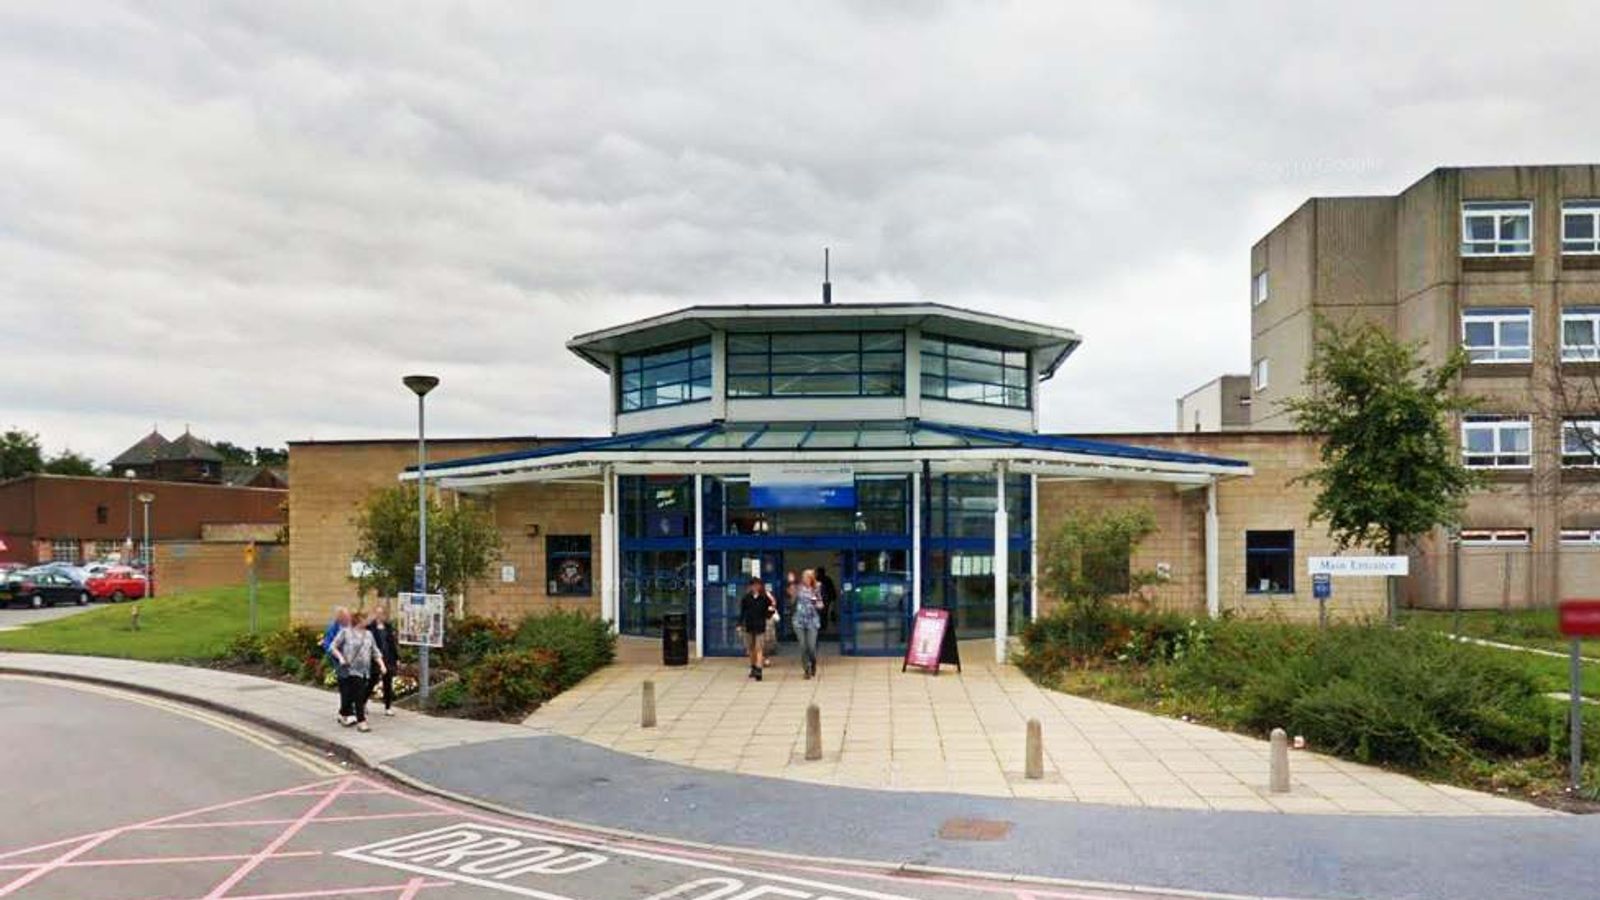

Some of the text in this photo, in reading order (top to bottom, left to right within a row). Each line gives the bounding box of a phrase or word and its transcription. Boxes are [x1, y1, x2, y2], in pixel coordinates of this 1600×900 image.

[1319, 559, 1397, 570] Main Entrance
[371, 830, 608, 879] DROP
